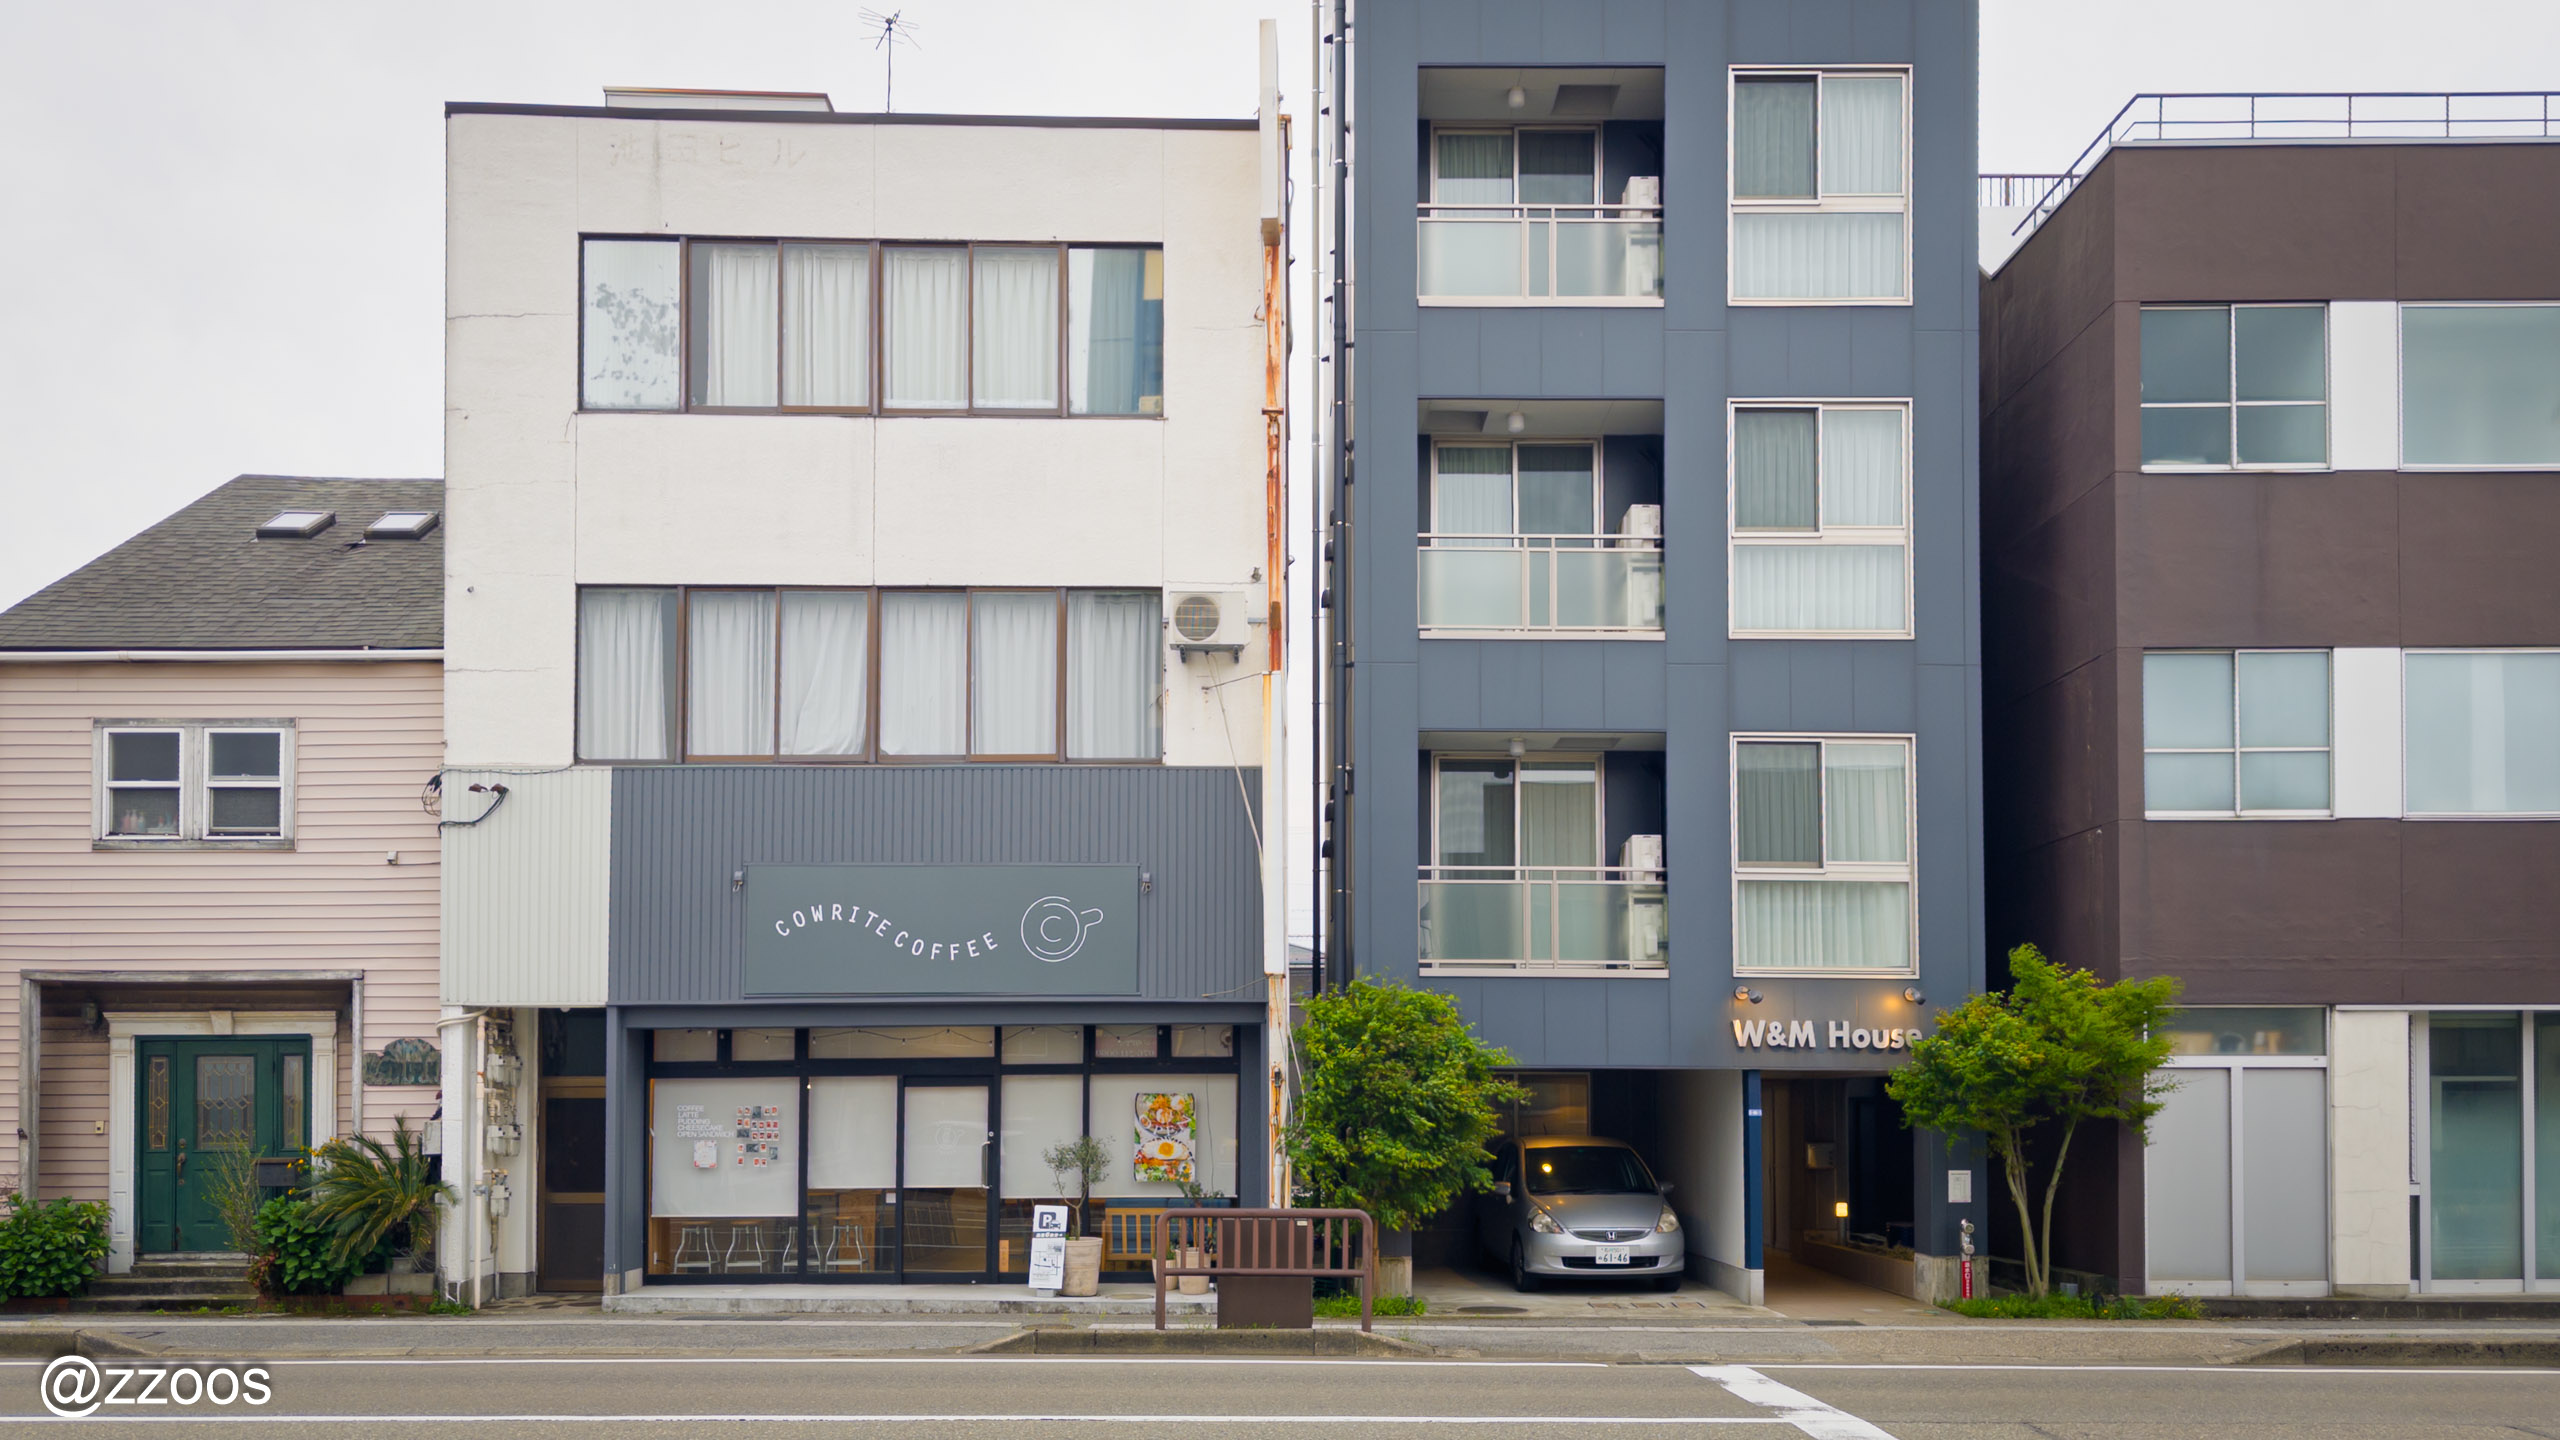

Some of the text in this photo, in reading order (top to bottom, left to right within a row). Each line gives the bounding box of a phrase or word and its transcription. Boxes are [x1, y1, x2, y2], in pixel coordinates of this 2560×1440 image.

[775, 904, 998, 960] COWRITE COFFEE
[1732, 1019, 1922, 1049] W&M House
